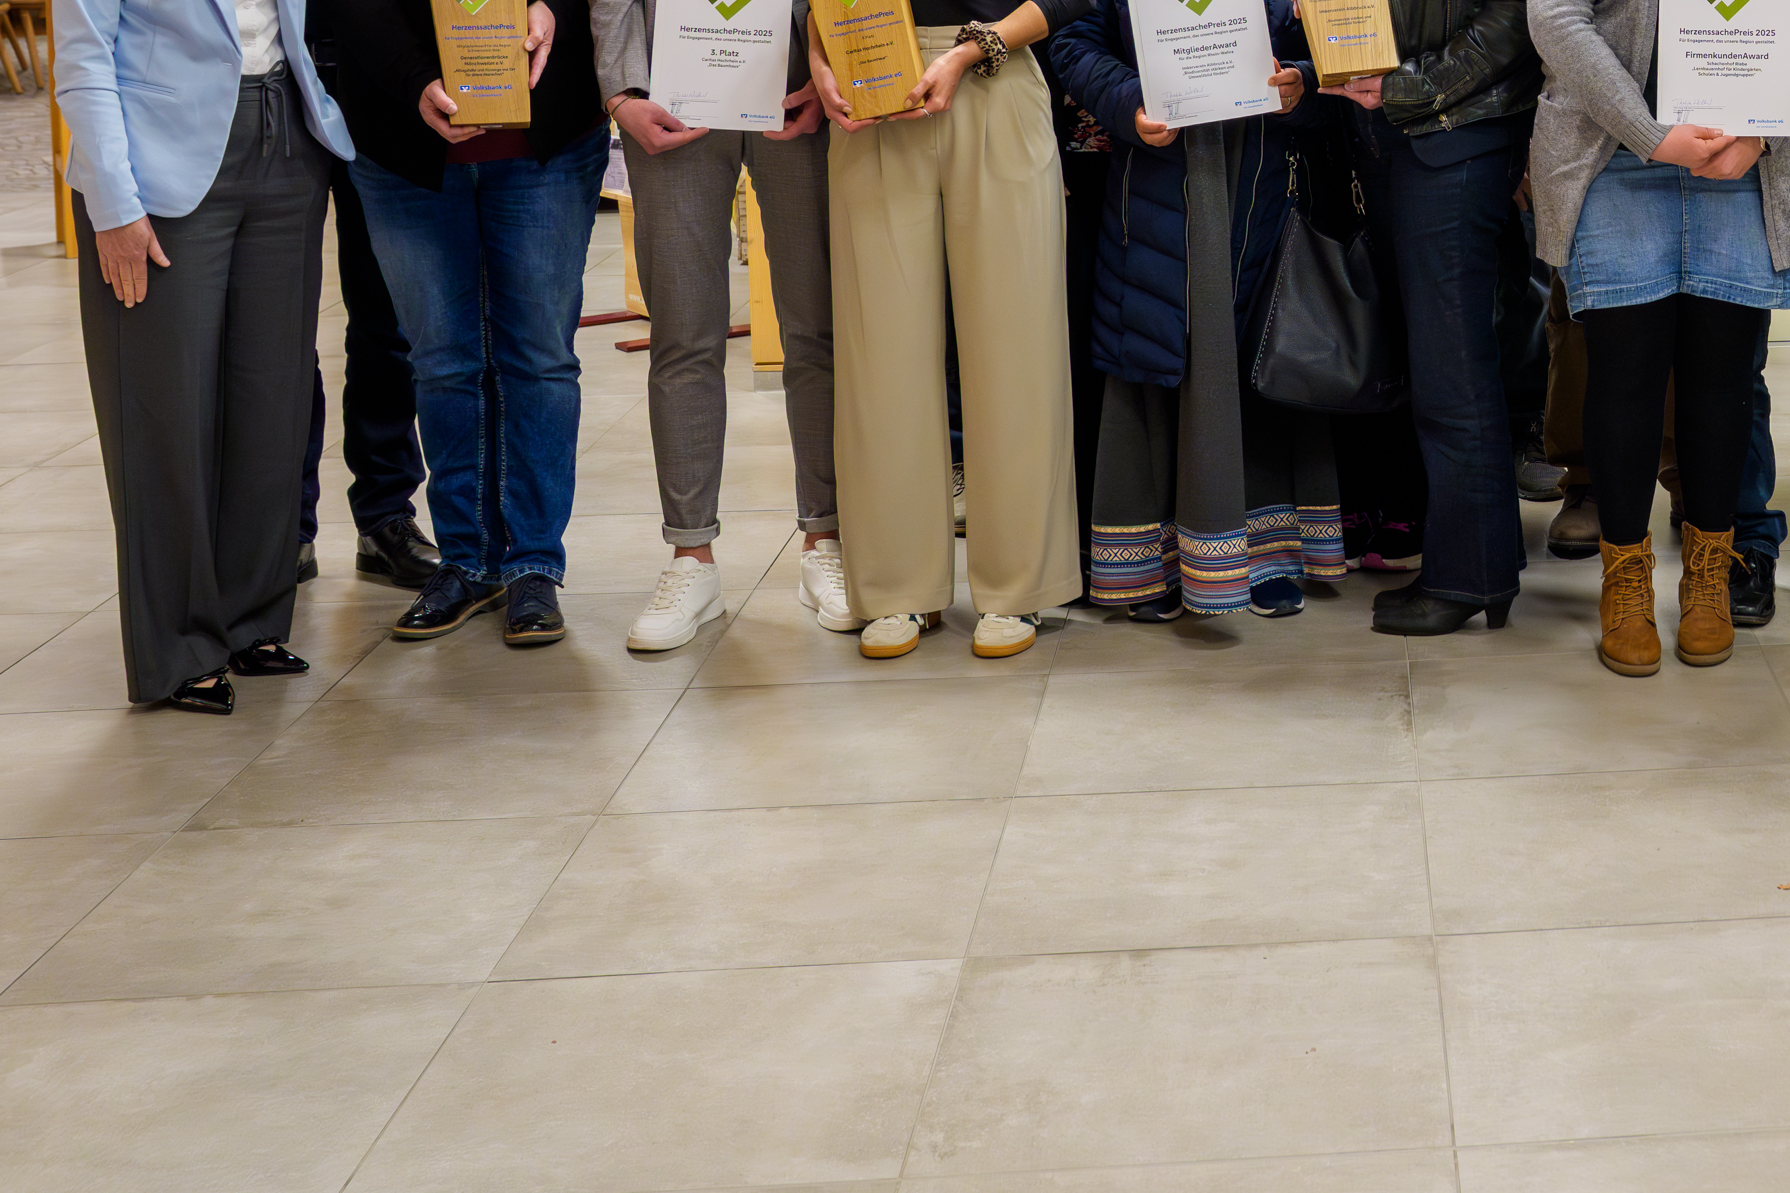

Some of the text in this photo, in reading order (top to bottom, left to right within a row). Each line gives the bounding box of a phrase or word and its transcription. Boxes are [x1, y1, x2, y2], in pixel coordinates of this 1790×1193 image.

[834, 10, 894, 27] HerzenssachePreis
[451, 23, 515, 31] HerzenssachePreis
[680, 25, 773, 37] HerzenssachePreis 2025
[1156, 17, 1247, 36] HerzenssachePreis 2025
[1339, 33, 1368, 41] Volksbank
[1679, 28, 1776, 37] HerzenssachePreis 2025
[719, 49, 739, 57] Platz
[1173, 40, 1237, 56] MitgliederAward
[1685, 51, 1769, 60] FirmenkundenAward
[864, 73, 893, 84] Volksbank
